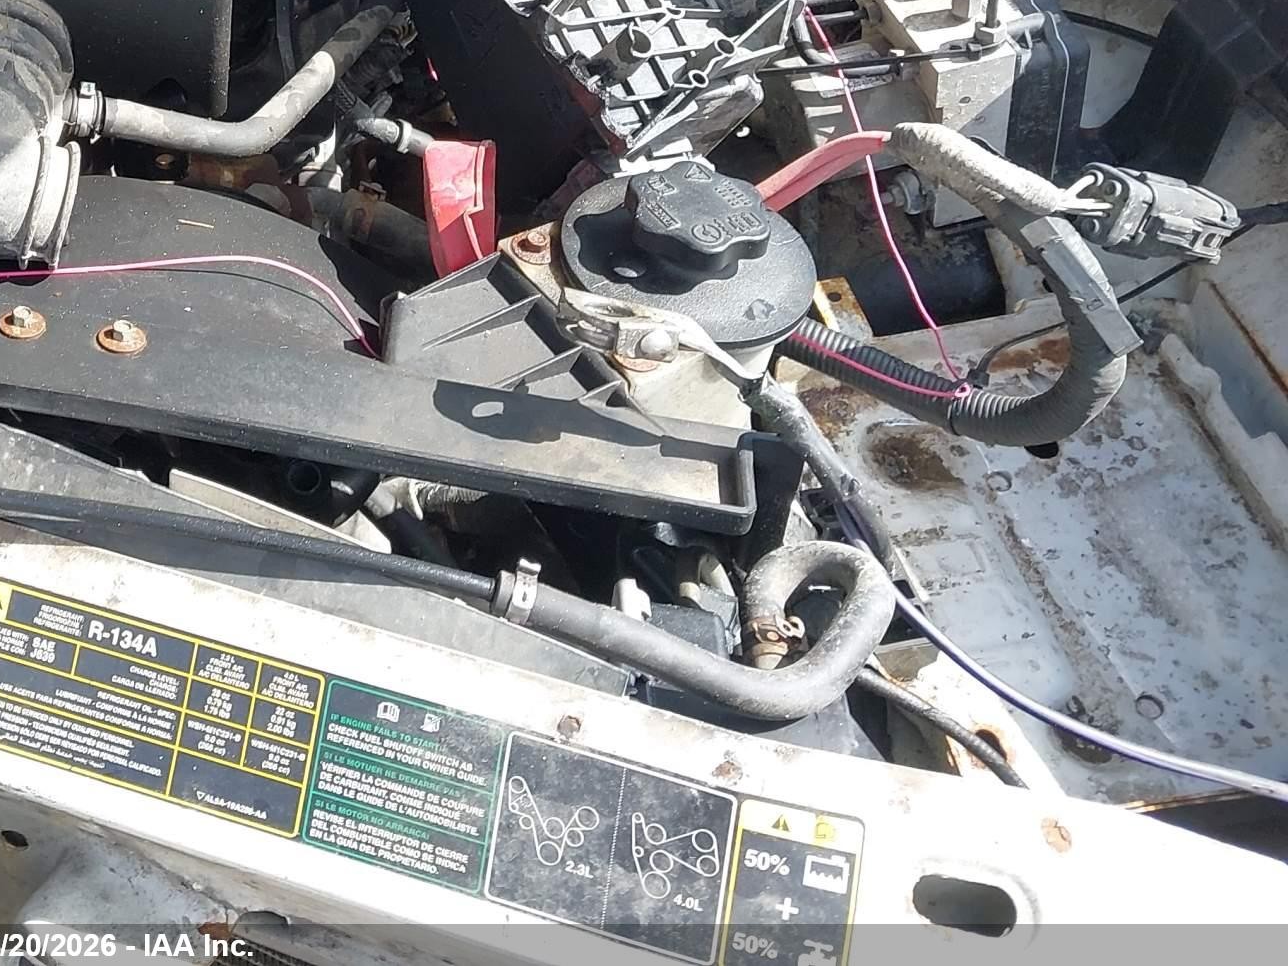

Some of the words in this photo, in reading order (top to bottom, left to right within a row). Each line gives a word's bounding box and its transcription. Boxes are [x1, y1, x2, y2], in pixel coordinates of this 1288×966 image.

[31, 636, 56, 652] SAE
[86, 619, 160, 657] R-134A
[29, 647, 55, 663] J639
[209, 657, 231, 669] FRONT
[231, 663, 244, 672] A/C
[111, 674, 134, 687] CARGA
[134, 682, 144, 690] DE
[129, 665, 157, 679] CHARGE
[198, 668, 210, 678] A/C
[210, 672, 250, 689] DELANTERO
[223, 669, 244, 680] AVANT
[210, 687, 221, 697] 28
[272, 675, 295, 687] FRONT
[295, 682, 307, 691] A/C
[287, 688, 308, 699] AVANT
[0, 681, 13, 692] USE
[13, 686, 35, 698] ACEITE
[35, 692, 52, 704] PARA
[52, 698, 104, 719] REFRIGERANTES
[104, 714, 140, 730] CONFORME
[97, 690, 141, 709] REFRIGERANT
[221, 701, 232, 711] kg
[261, 687, 273, 696] A/C
[273, 691, 314, 708] DELANTERO
[95, 701, 131, 717] CONFORME
[137, 714, 146, 722] LA
[147, 716, 171, 729] NORME
[270, 714, 285, 725] 0.91
[285, 719, 296, 730] kg
[1, 711, 28, 725] PRESSION
[31, 721, 67, 738] TECHNICIENS
[96, 741, 130, 757] SEULEMENT.
[21, 707, 48, 721] SERVICED
[48, 716, 63, 726] ONLY
[62, 720, 71, 728] BY
[71, 723, 100, 737] QUALIFIED
[99, 731, 135, 748] PERSONNEL.
[266, 722, 282, 734] 2.00
[340, 716, 372, 731] ENGINE
[373, 726, 397, 738] FAILS
[399, 733, 410, 742] TO
[203, 734, 215, 743] 9.0
[328, 723, 359, 738] CHECK
[359, 732, 382, 745] FUEL
[383, 739, 423, 756] SHUTOFF
[424, 751, 459, 767] SWITCH
[459, 761, 473, 771] AS
[34, 731, 49, 741] DEBE
[49, 736, 60, 745] SER
[60, 739, 87, 754] REVISADO
[87, 748, 99, 757] POR
[99, 751, 128, 766] PERSONAL
[128, 760, 162, 776] CALIFICADO.
[213, 745, 226, 756] cc)
[267, 753, 279, 762] 9.0
[326, 732, 384, 755] REFERENCED
[384, 749, 394, 758] IN
[395, 753, 421, 766] YOUR
[421, 760, 455, 776] OWNER
[456, 770, 487, 786] GUIDE.
[277, 765, 290, 775] cc)
[323, 751, 332, 759] SI
[333, 754, 345, 763] LE
[384, 769, 396, 779] NE
[319, 771, 332, 781] DE
[332, 775, 389, 798] CARBURANT,
[389, 792, 423, 808] COMME
[423, 802, 461, 820] INDIQUÉ
[321, 760, 361, 779] VÉRIFIER
[361, 773, 373, 784] LA
[374, 777, 425, 799] COMMANDE
[426, 792, 440, 803] DE
[440, 797, 485, 817] COUPURE
[315, 799, 323, 807] SI
[325, 802, 336, 811] LE
[337, 806, 369, 821] MOTOR
[370, 816, 383, 825] NO
[318, 780, 343, 794] DANS
[343, 788, 355, 798] LE
[355, 792, 384, 807] GUIDE
[384, 800, 397, 811] DE
[397, 804, 480, 836] L'AUTOMOBILISTE.
[311, 818, 329, 830] DEL
[329, 824, 393, 849] COMBUSTIBLE
[392, 843, 420, 858] COMO
[421, 852, 434, 862] SE
[434, 856, 466, 873] INDICA
[312, 809, 344, 825] REVISE
[344, 819, 357, 829] EL
[357, 822, 420, 848] INTERRUPTOR
[420, 841, 434, 852] DE
[434, 846, 469, 863] CIERRE
[309, 828, 322, 838] EN
[322, 832, 335, 842] LA
[335, 836, 358, 850] GUÍA
[358, 843, 377, 855] DEL
[377, 849, 439, 874] PROPIETARIO.
[743, 847, 792, 876] 50%
[564, 860, 595, 879] 2.3L
[672, 893, 703, 913] 4.0L
[730, 930, 780, 960] 50%
